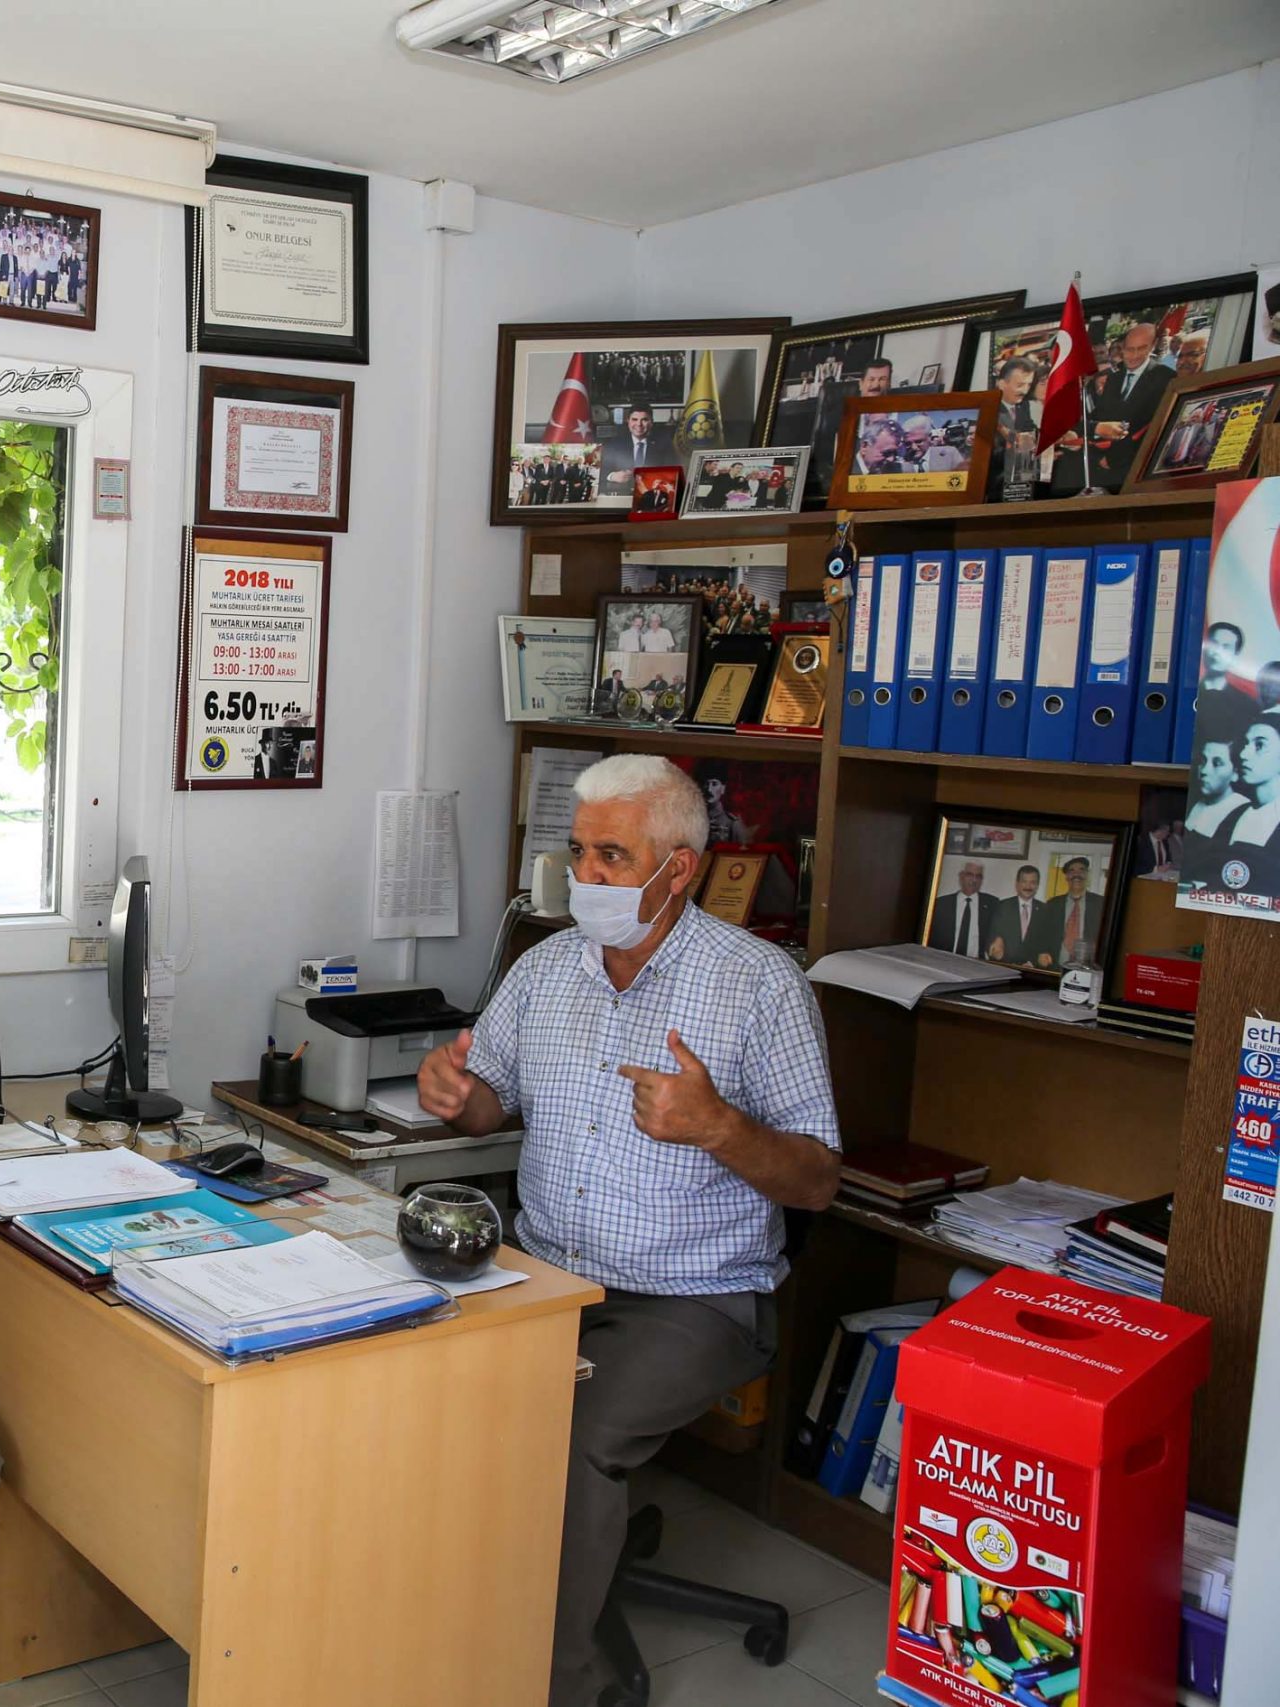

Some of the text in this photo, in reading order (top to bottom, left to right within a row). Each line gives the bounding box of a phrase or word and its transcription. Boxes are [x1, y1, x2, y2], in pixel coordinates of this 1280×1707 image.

[245, 231, 312, 246] ONUR BELGESİ
[224, 569, 294, 589] 2018 YILI
[212, 591, 304, 603] MUHTARLIK ÜCRET TARİFESİ
[211, 619, 304, 630] MUHTARLIK MESAİ SAATLERİ
[218, 632, 234, 640] YASA
[236, 632, 260, 641] GEREĞİ
[213, 646, 240, 658] 09:00
[250, 647, 275, 659] 13:00
[278, 652, 297, 660] ARASI
[213, 663, 239, 675] 13:00
[249, 664, 274, 676] 17:00
[204, 690, 257, 721] 6.50
[206, 724, 259, 734] MUHTARLIK ÜC
[1240, 1084, 1265, 1094] BİZDEN
[1236, 1117, 1272, 1140] 460
[1234, 1190, 1251, 1201] 442
[1254, 1194, 1265, 1205] 70
[1046, 1292, 1123, 1319] ATIK PİL
[993, 1287, 1169, 1342] TOPLAMA KUTUSU
[949, 1319, 971, 1329] KUTU
[970, 1323, 1026, 1345] DOLDUĞUNDA
[1025, 1340, 1083, 1361] BELEDİYENİZİ
[929, 1434, 1065, 1505] ATIK PİL
[914, 1459, 999, 1502] TOPLAMA
[1003, 1490, 1081, 1531] KUTUSU
[920, 1668, 942, 1683] ATIK
[944, 1677, 980, 1700] PİLLERİ
